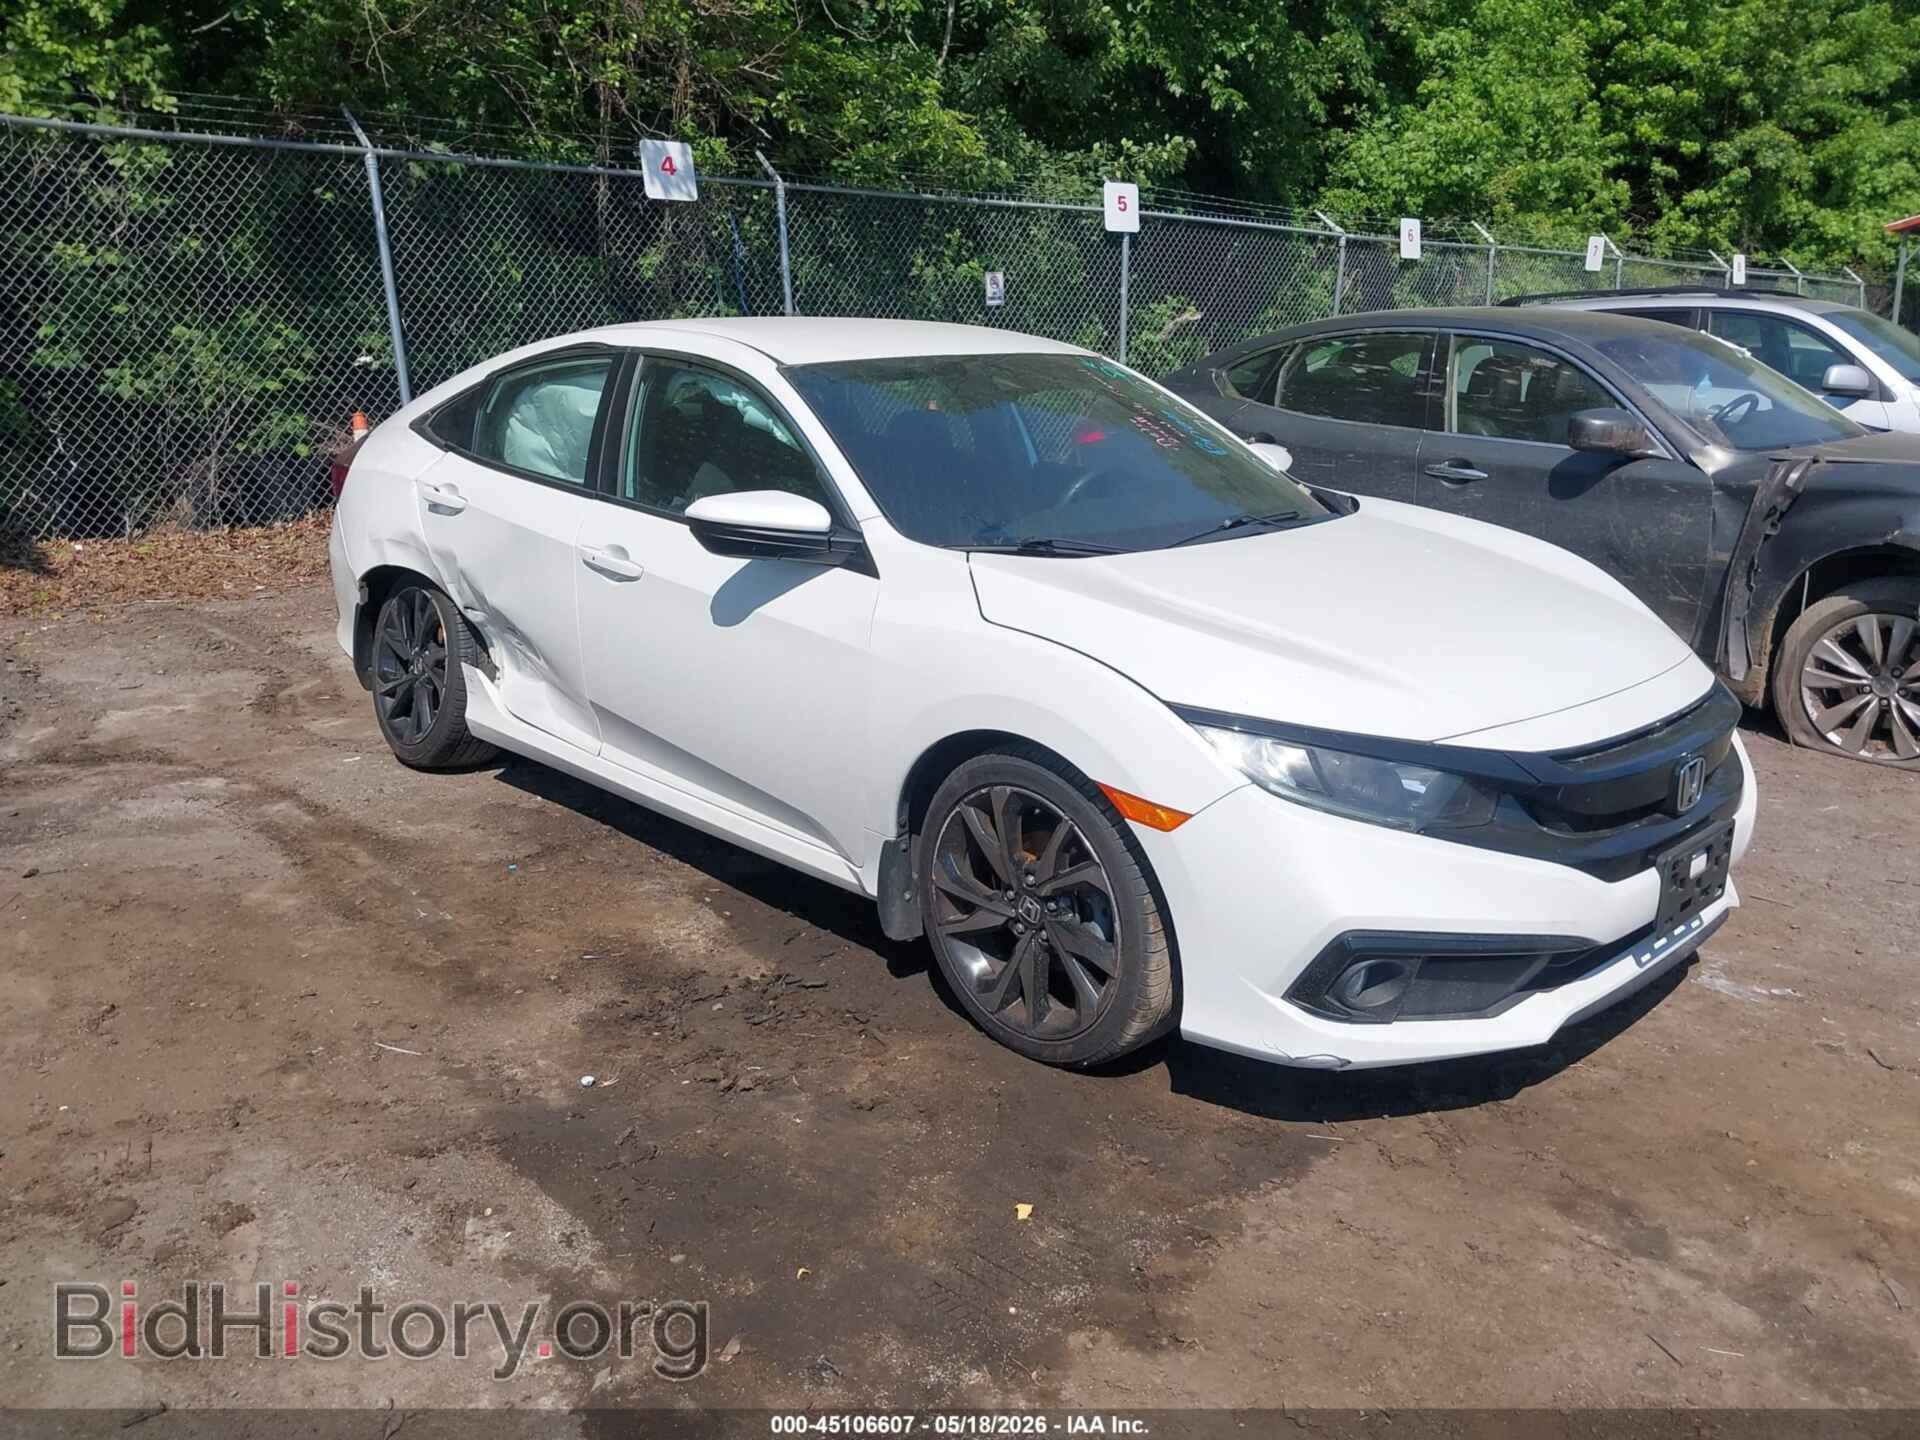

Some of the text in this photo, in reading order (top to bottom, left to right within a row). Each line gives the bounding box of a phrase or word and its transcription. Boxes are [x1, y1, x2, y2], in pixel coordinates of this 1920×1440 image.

[661, 156, 677, 176] 4
[1117, 195, 1128, 213] 5
[1407, 229, 1414, 242] 6
